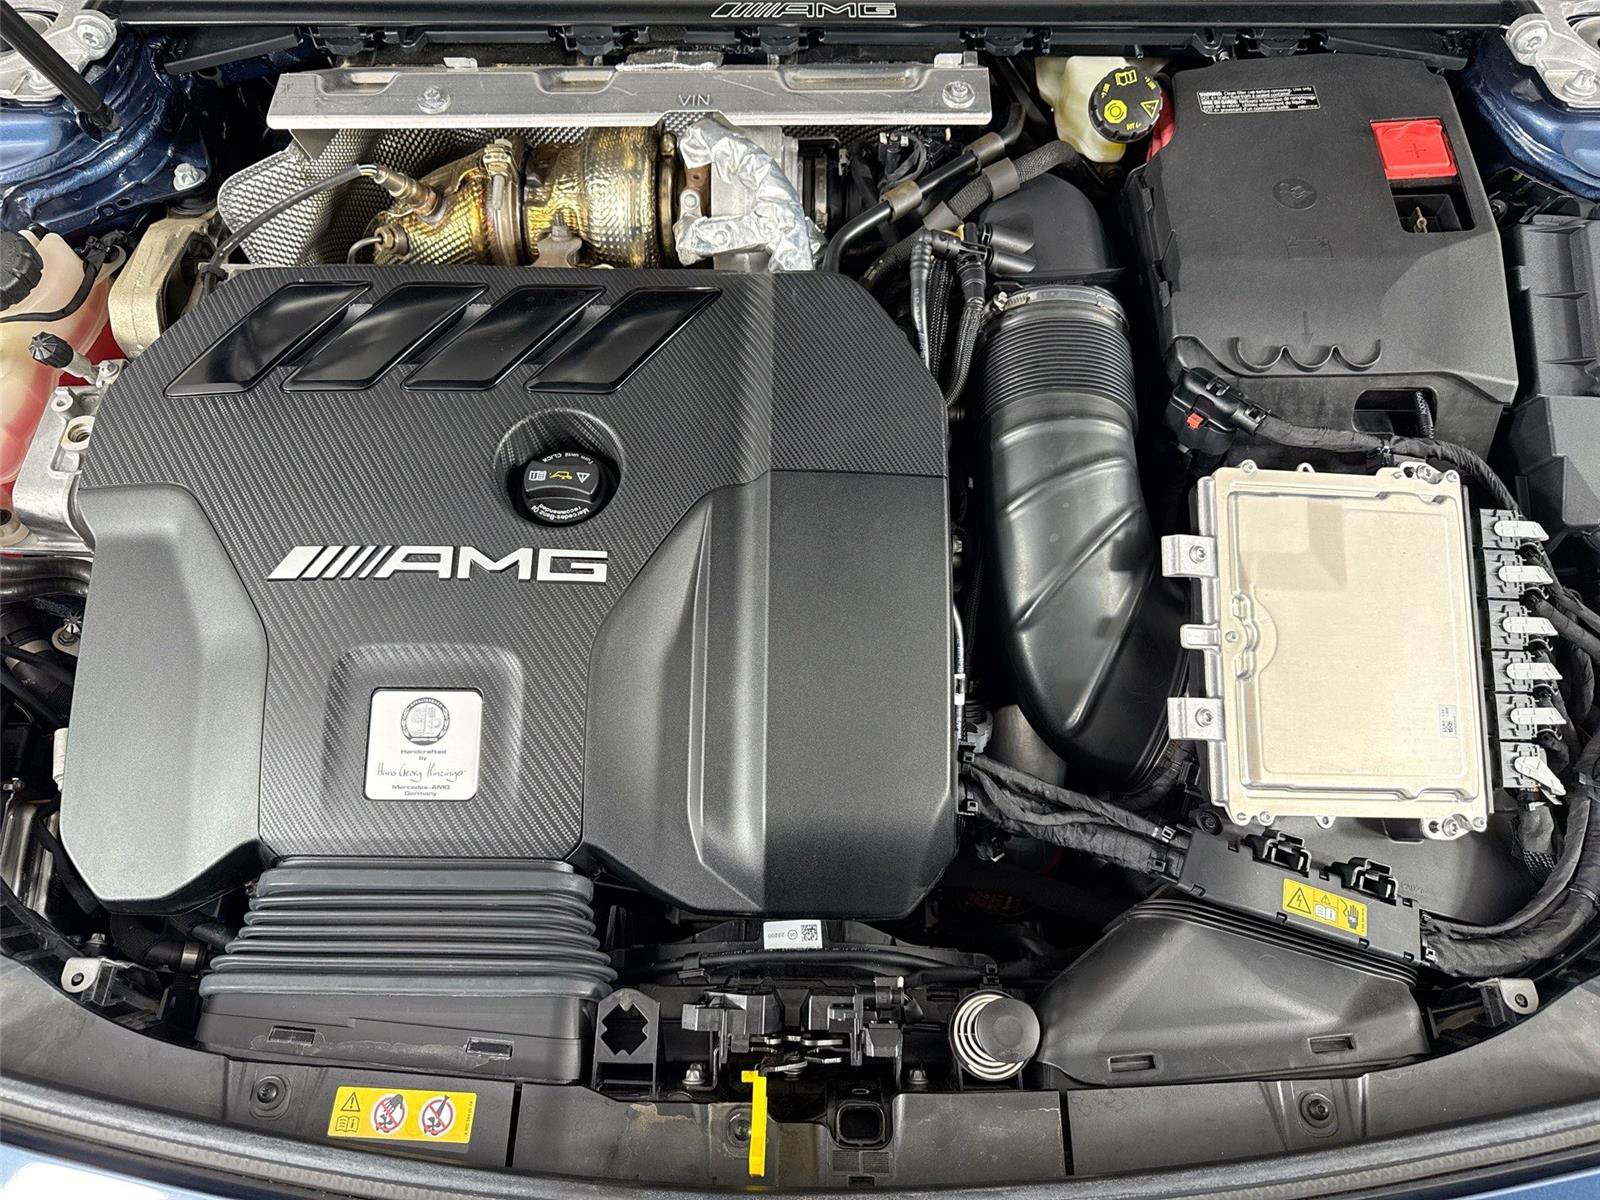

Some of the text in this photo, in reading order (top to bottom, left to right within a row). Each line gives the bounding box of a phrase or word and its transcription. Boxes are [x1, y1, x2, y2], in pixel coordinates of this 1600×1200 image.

[771, 2, 897, 18] AMG
[678, 94, 711, 107] VIN
[542, 452, 562, 463] CLICK
[538, 503, 582, 515] recommended
[539, 507, 590, 520] Mercedes-Benz
[372, 545, 608, 583] AMG
